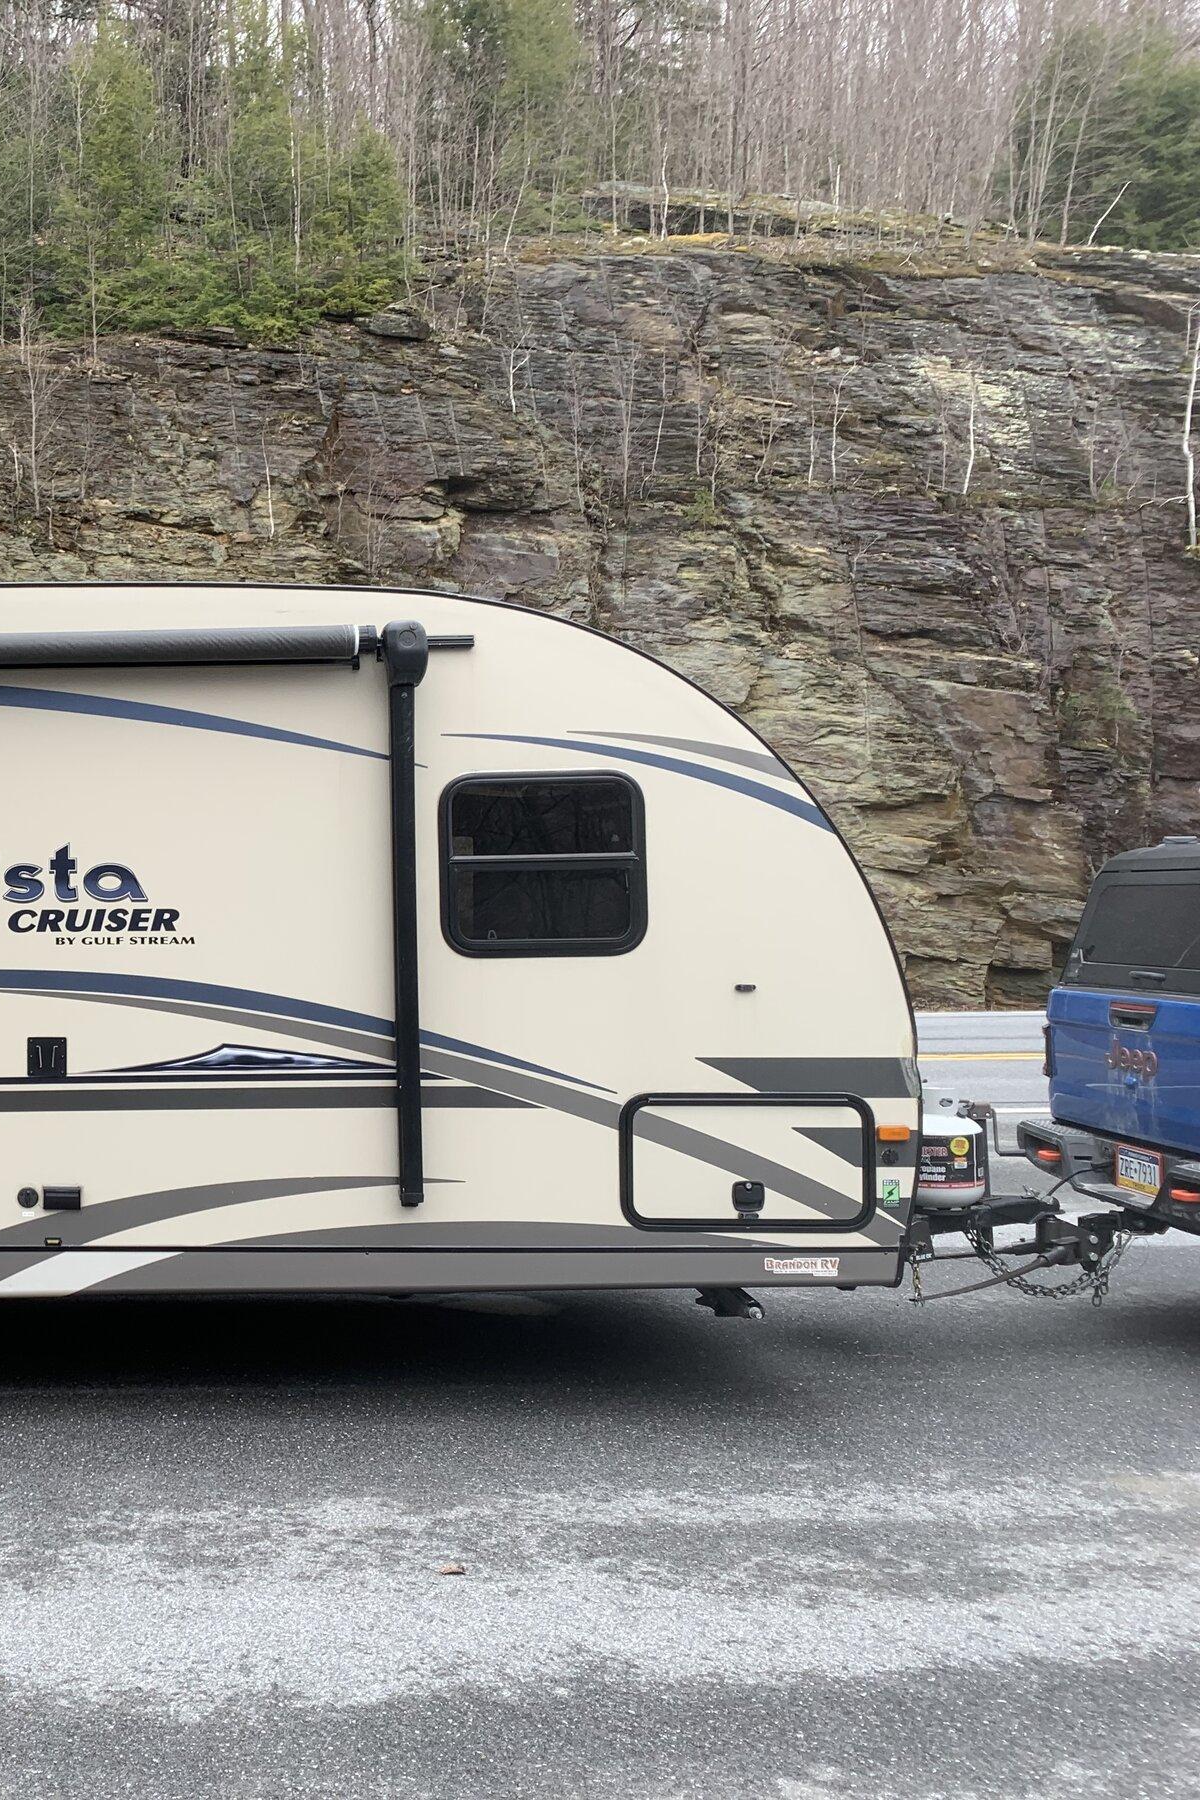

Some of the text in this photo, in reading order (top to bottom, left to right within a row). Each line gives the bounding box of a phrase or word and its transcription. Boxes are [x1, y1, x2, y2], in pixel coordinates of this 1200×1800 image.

[7, 908, 180, 933] CRUISER
[55, 936, 196, 945] BY GULF STREAM
[1104, 1039, 1158, 1079] Jeep
[766, 1259, 838, 1270] BRANDON RV
